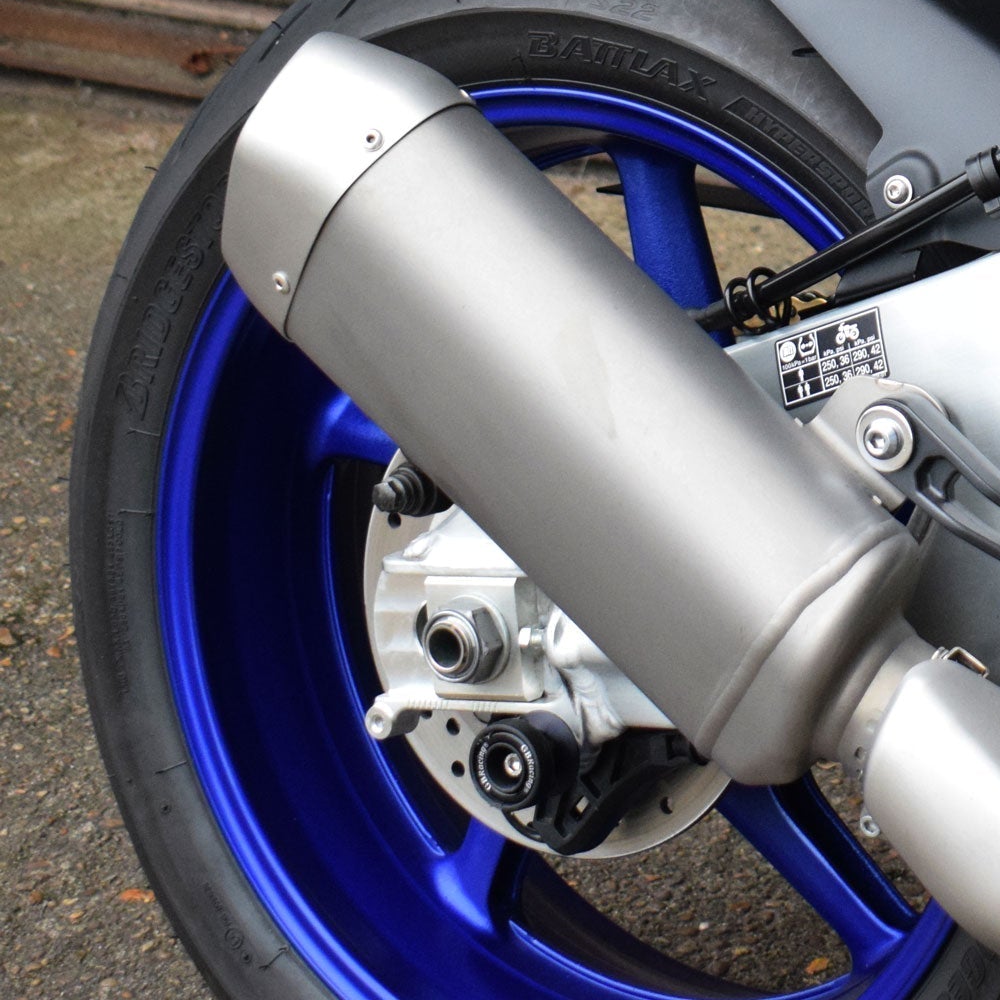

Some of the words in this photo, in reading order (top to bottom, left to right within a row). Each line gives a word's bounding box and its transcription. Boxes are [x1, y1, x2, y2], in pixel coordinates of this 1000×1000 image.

[528, 31, 716, 102] BATTLAX
[744, 105, 876, 224] HYPERSPOR
[840, 354, 850, 366] 36
[870, 343, 881, 355] 42
[873, 359, 884, 371] 42
